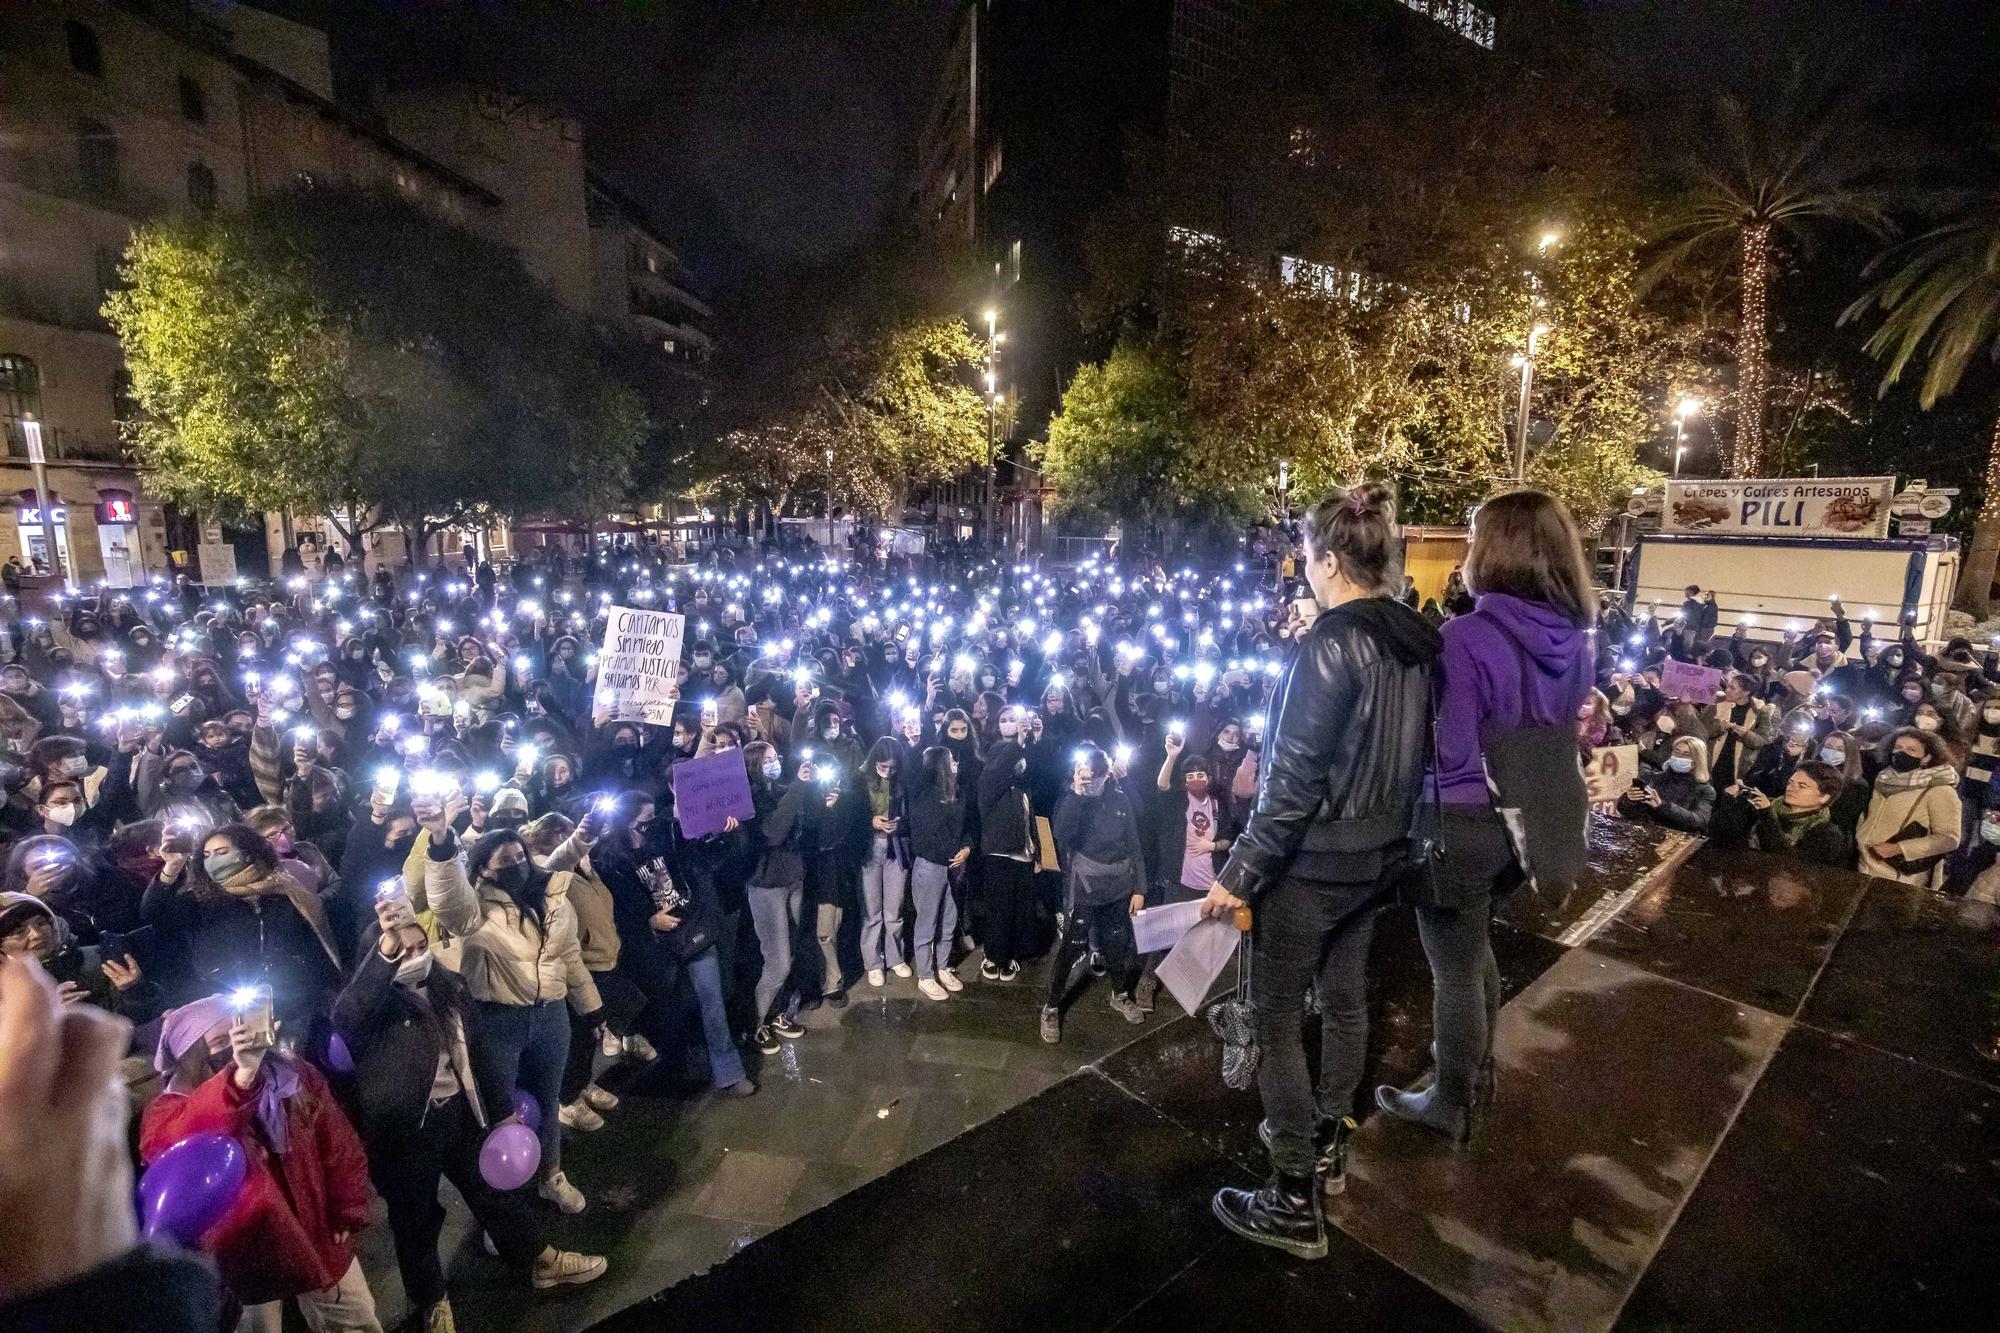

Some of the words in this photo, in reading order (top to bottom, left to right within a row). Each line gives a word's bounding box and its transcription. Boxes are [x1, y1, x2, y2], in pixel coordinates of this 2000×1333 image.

[1732, 488, 1740, 498] y
[1743, 486, 1789, 498] Gofres
[1793, 485, 1870, 498] Artesanos
[20, 508, 66, 523] KC
[1740, 501, 1805, 527] PILI
